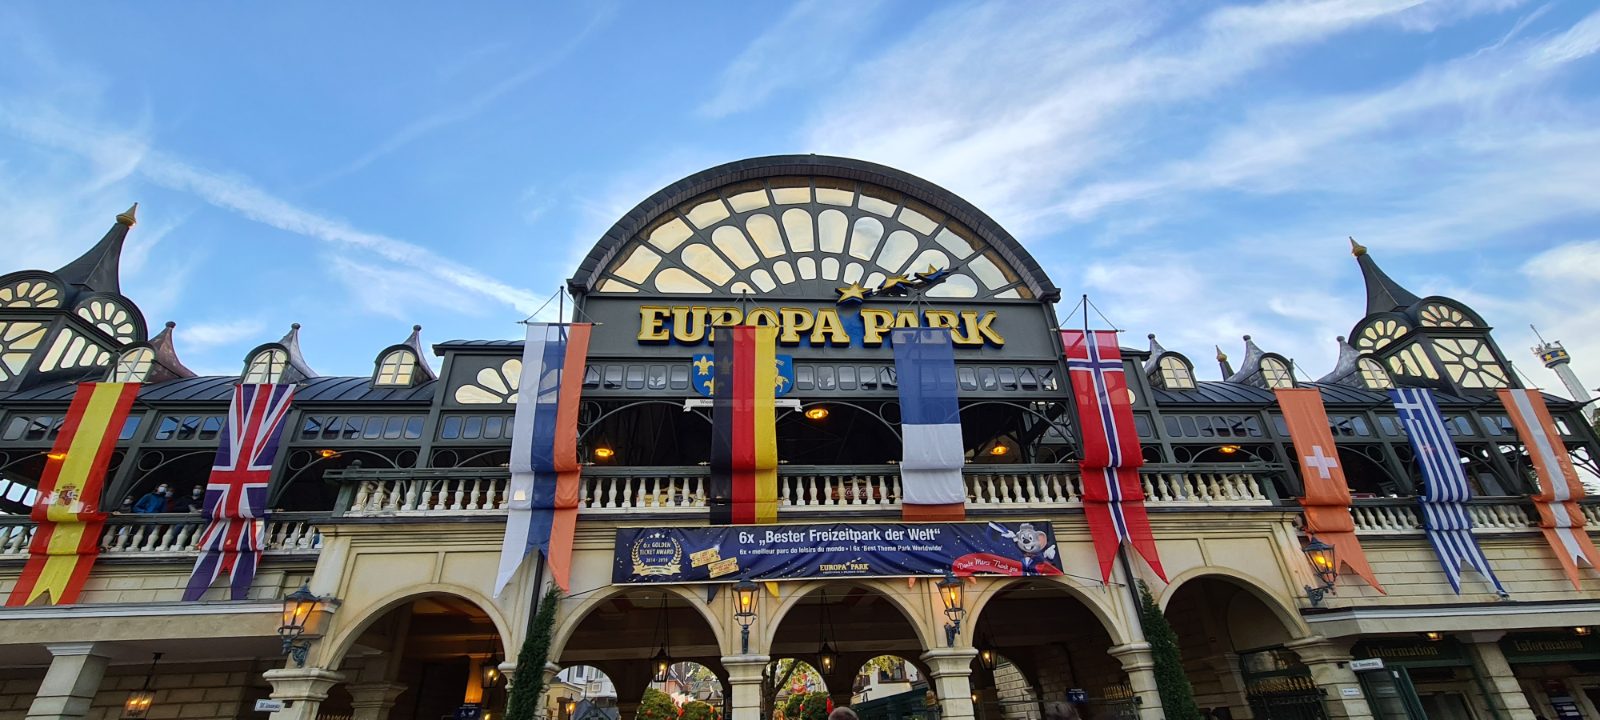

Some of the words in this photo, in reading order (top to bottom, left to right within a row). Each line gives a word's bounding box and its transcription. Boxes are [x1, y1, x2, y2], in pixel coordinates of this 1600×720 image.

[637, 305, 850, 346] EUROPA
[859, 308, 1006, 348] PARK
[739, 531, 754, 544] 6x
[809, 528, 882, 543] Freizeitpark
[885, 528, 905, 541] der
[897, 544, 911, 552] Park
[993, 559, 1009, 570] Thank
[1365, 644, 1439, 658] Information
[1513, 638, 1584, 651] Information
